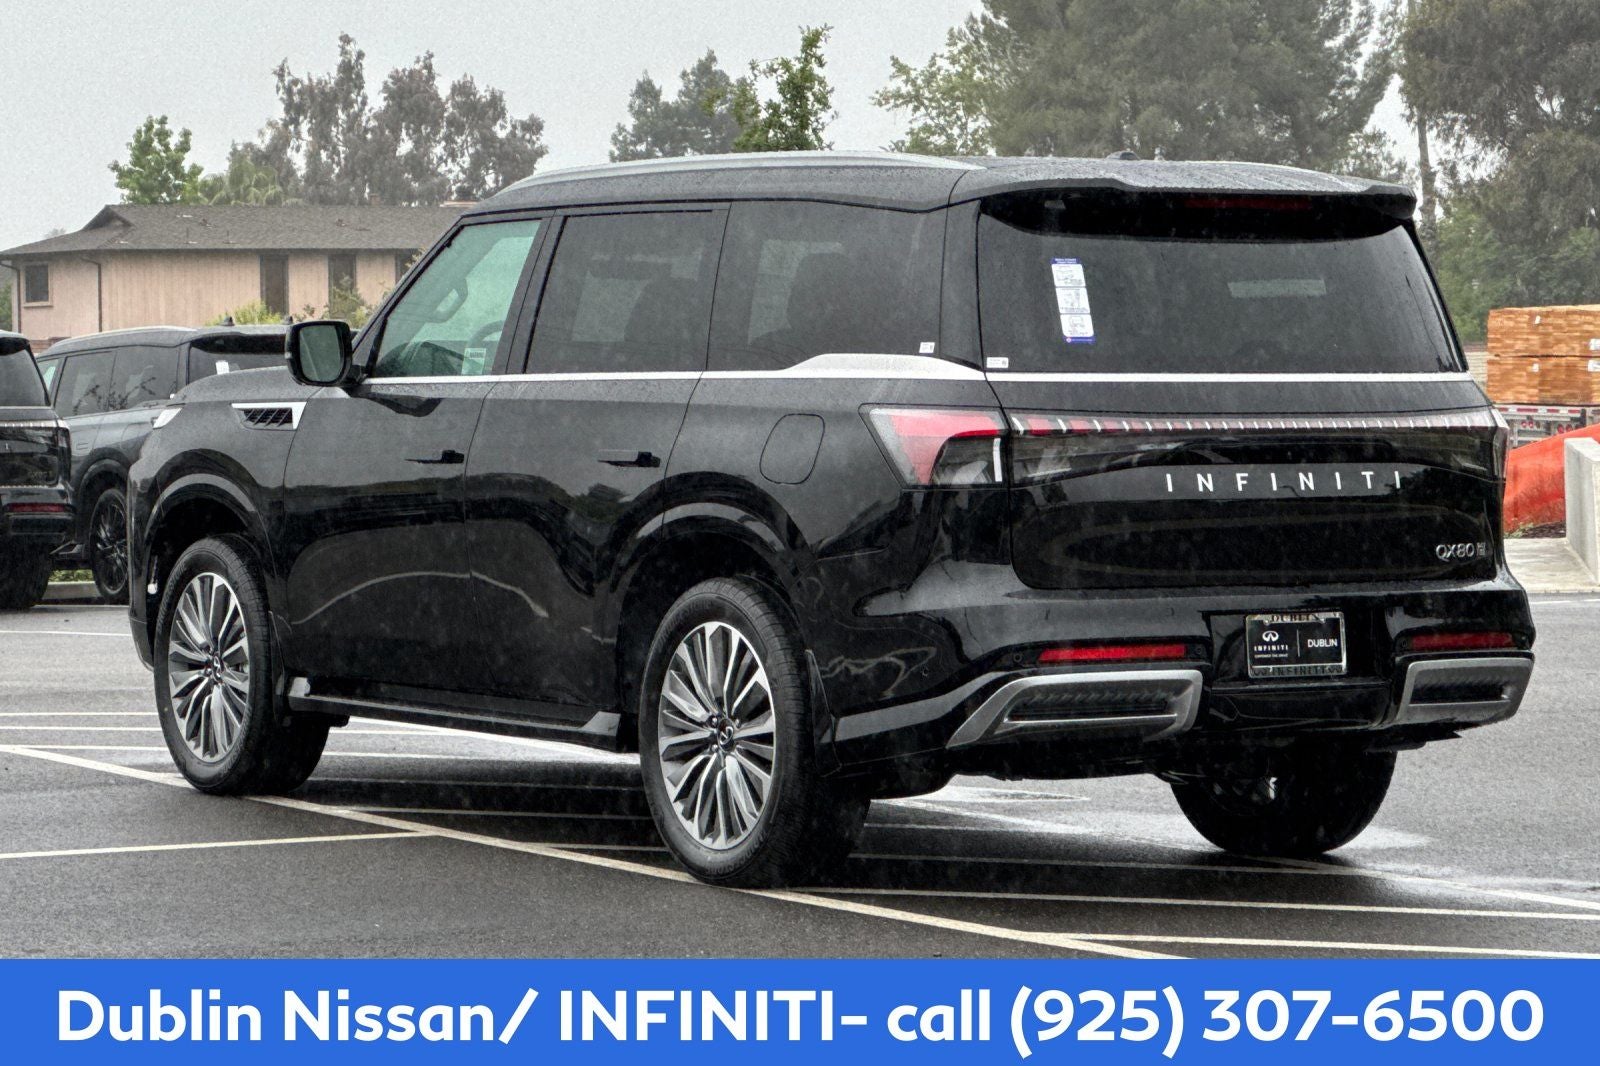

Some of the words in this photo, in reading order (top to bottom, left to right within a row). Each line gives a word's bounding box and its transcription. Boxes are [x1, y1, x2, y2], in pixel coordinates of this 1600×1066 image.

[1164, 470, 1406, 494] INFINITI
[1435, 542, 1475, 562] QX80
[1253, 644, 1289, 652] INFINITI
[1307, 638, 1338, 648] DUBLIN
